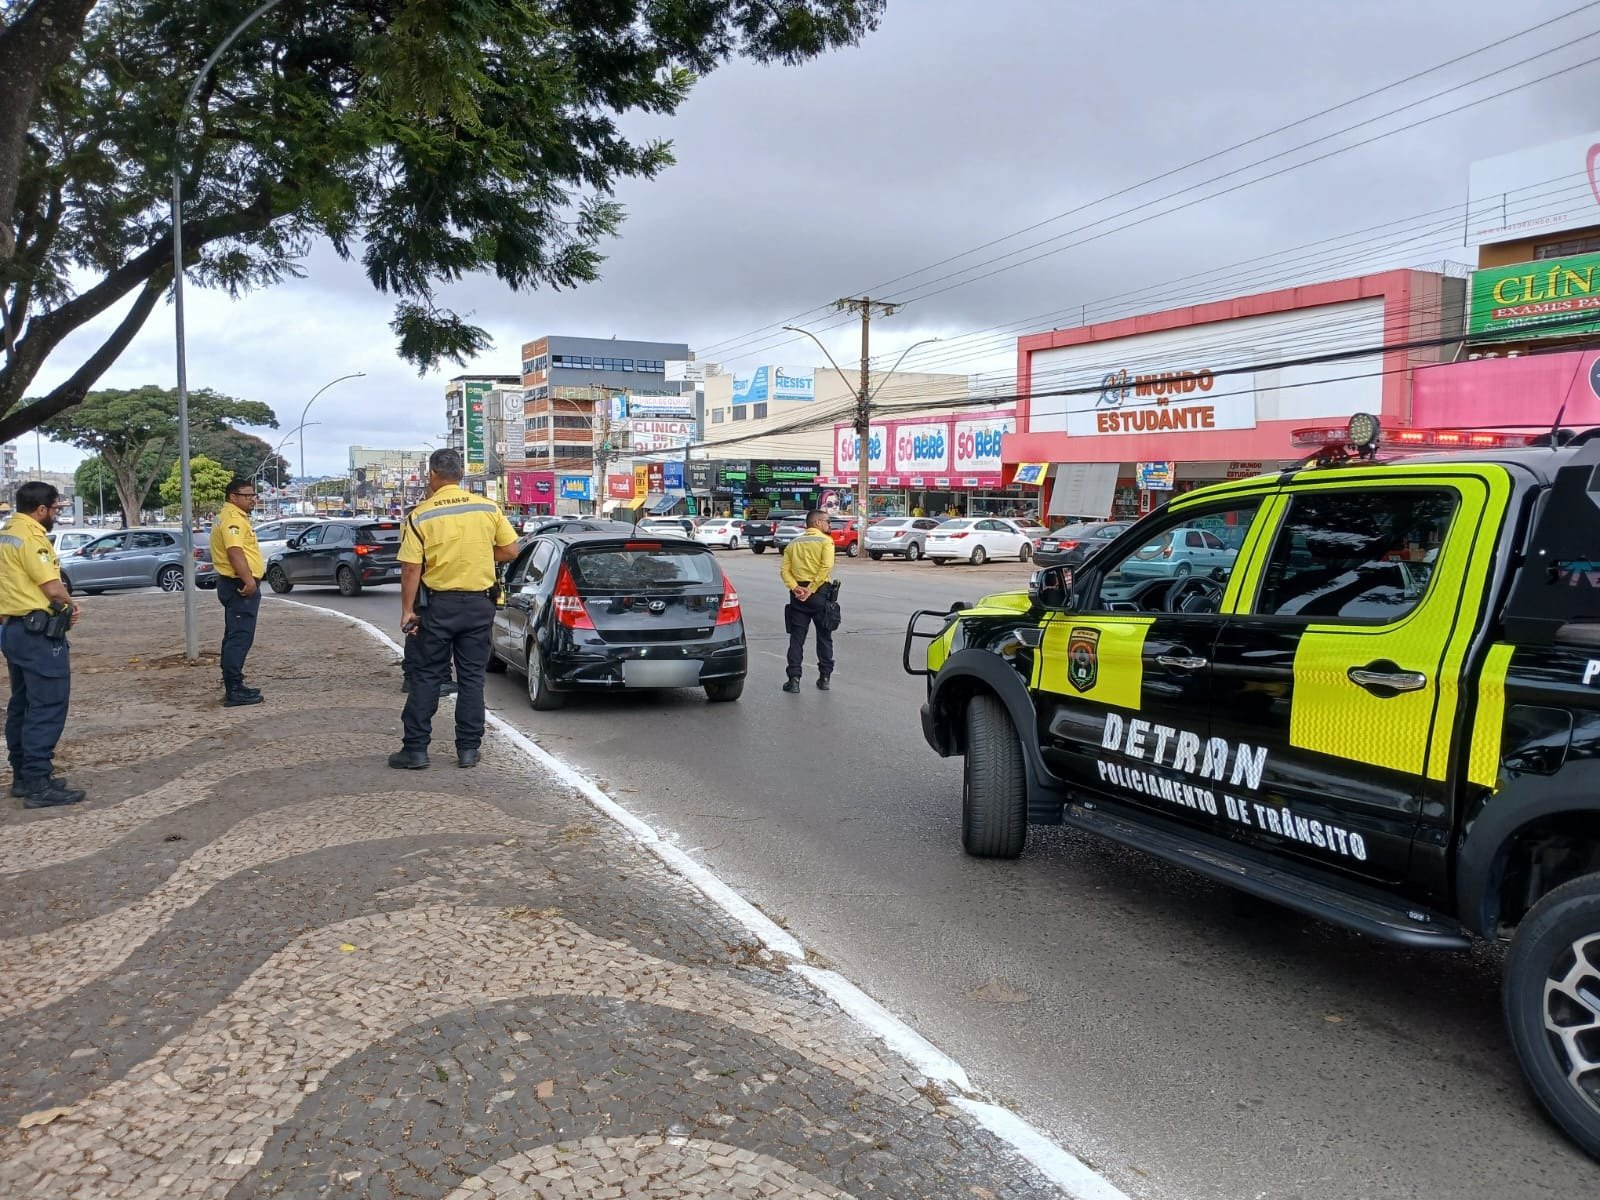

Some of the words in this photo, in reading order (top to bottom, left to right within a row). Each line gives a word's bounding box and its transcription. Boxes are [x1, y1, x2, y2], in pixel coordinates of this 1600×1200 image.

[1496, 301, 1572, 317] EXAMES
[775, 378, 813, 389] RESIST
[1135, 369, 1214, 396] MUNDO
[1157, 397, 1169, 406] DO
[1096, 406, 1215, 433] ESTUDANTE
[854, 431, 882, 462] BBÊ
[898, 431, 913, 462] SÓ
[957, 425, 974, 461] SÓ
[975, 423, 1008, 459] BEB
[433, 496, 470, 507] DETRAN-DF
[1101, 712, 1268, 790] DETRAN
[1097, 760, 1218, 816] POLICIAMENTO
[1224, 795, 1252, 825] DE
[1253, 804, 1367, 861] TRÂNSITO
